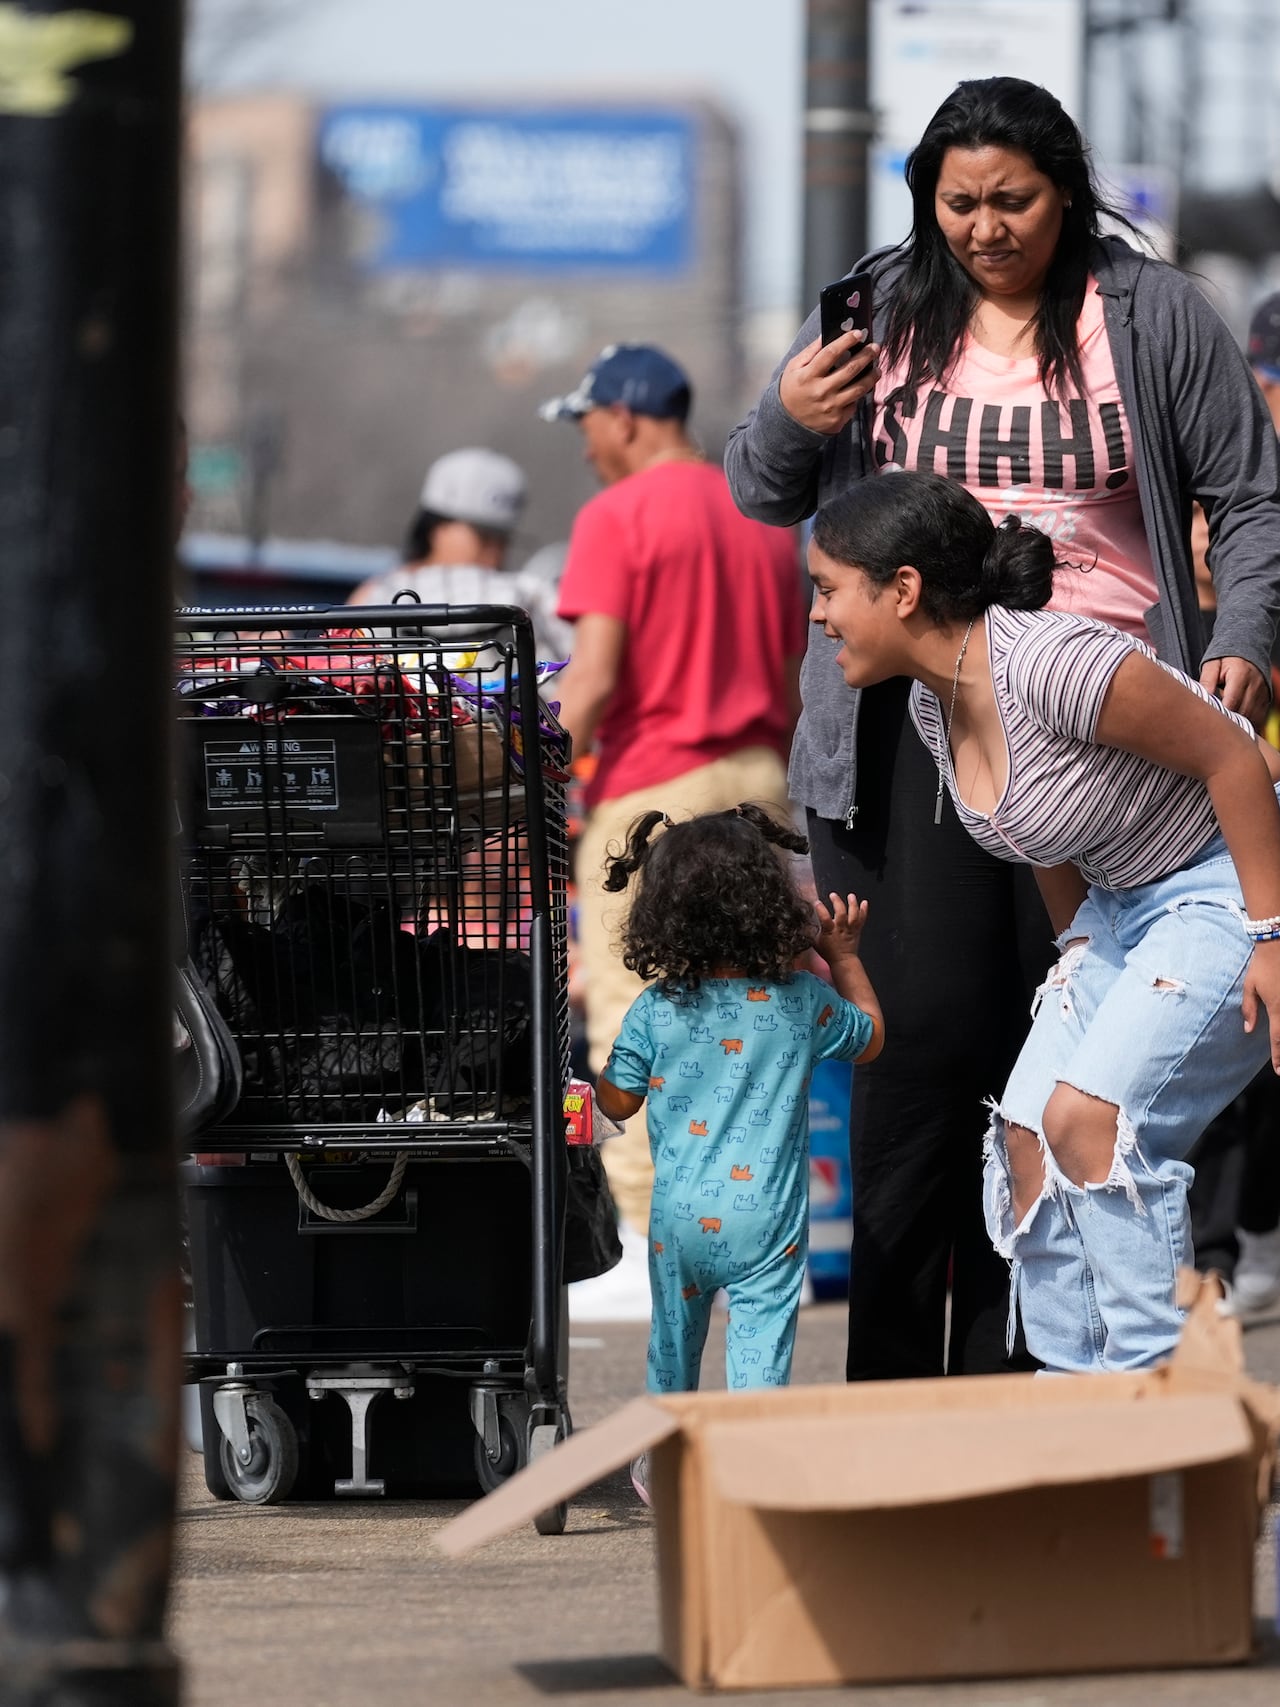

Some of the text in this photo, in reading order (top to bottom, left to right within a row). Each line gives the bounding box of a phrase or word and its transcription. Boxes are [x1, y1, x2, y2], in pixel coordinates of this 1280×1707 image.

[875, 386, 1130, 490] SHHH!
[214, 605, 315, 613] MARKETPLACE
[250, 742, 300, 752] WRING
